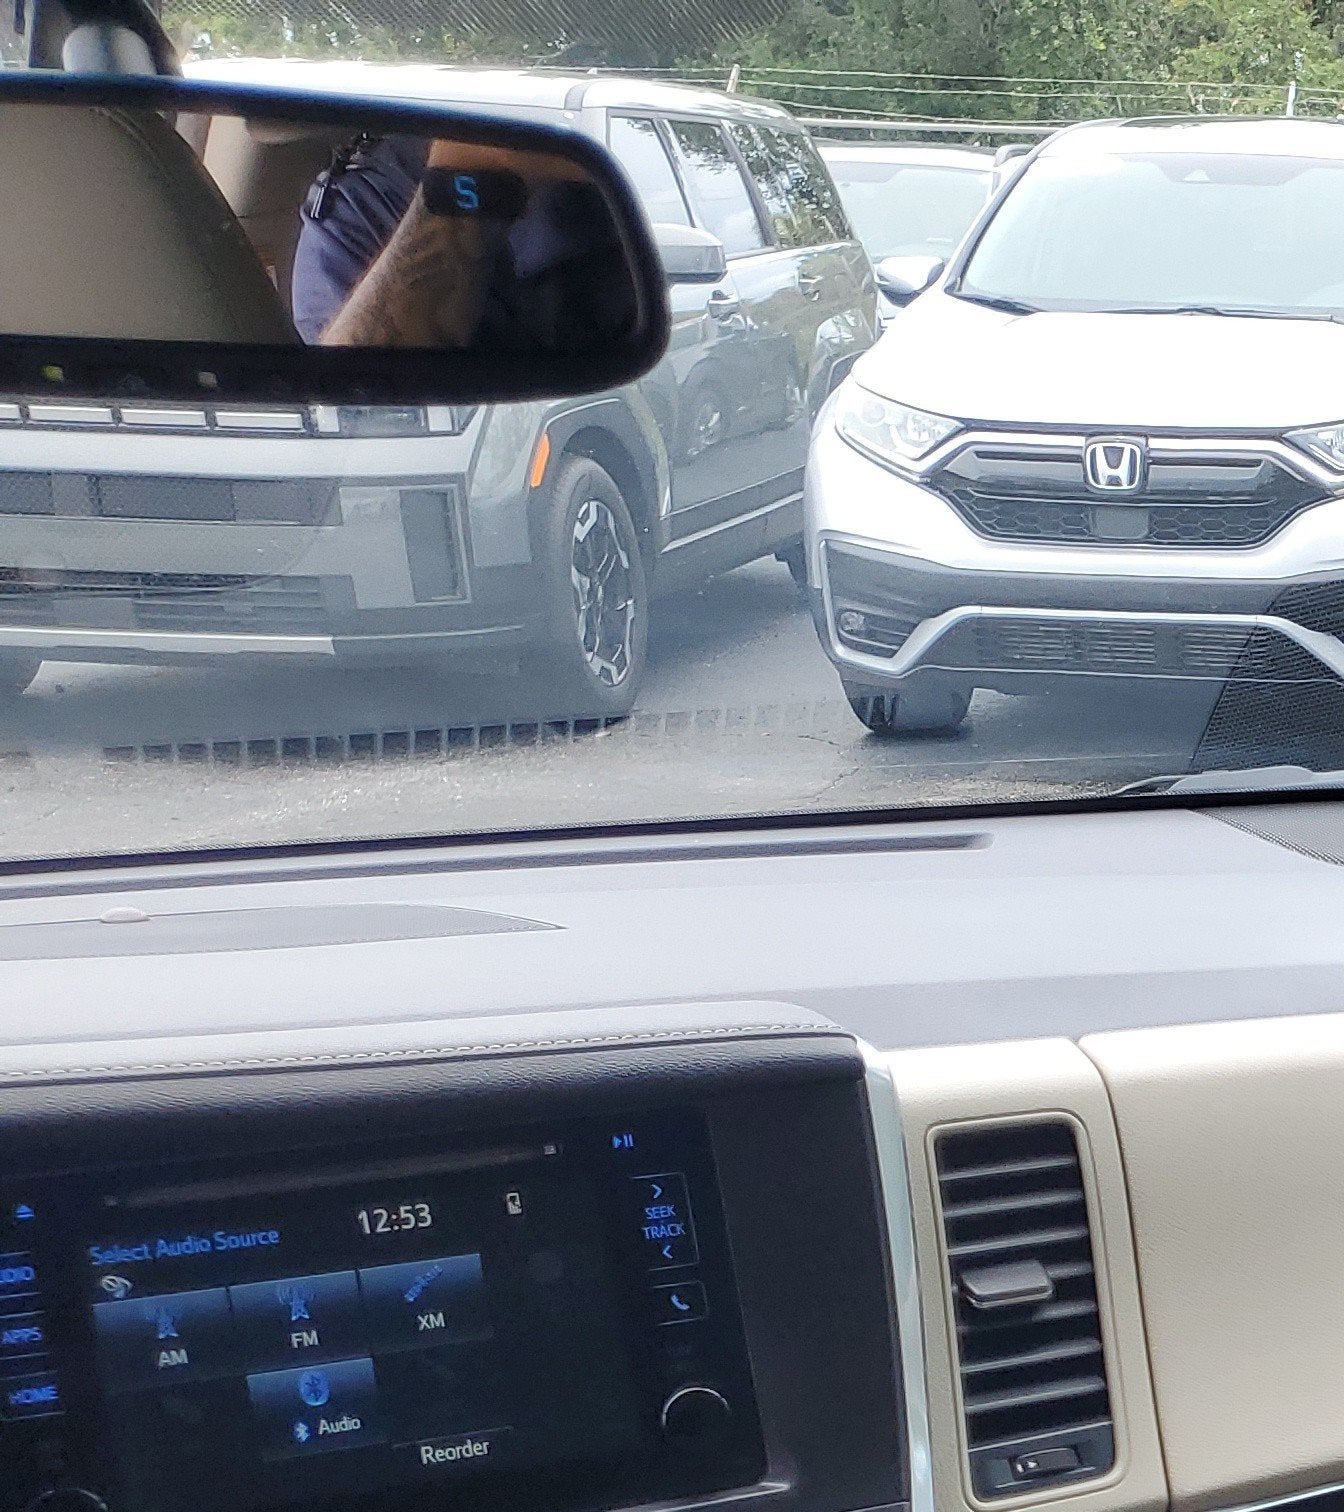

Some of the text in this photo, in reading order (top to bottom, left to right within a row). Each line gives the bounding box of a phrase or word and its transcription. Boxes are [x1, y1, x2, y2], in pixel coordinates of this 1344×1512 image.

[357, 1202, 433, 1237] 12:53
[644, 1203, 677, 1220] SEEK
[642, 1221, 686, 1240] TRACK
[90, 1227, 280, 1266] Select Audio Source
[417, 1311, 446, 1332] XM
[291, 1330, 320, 1349] FM
[157, 1348, 188, 1369] AM
[318, 1413, 362, 1437] Audio
[420, 1437, 491, 1466] Reorder
